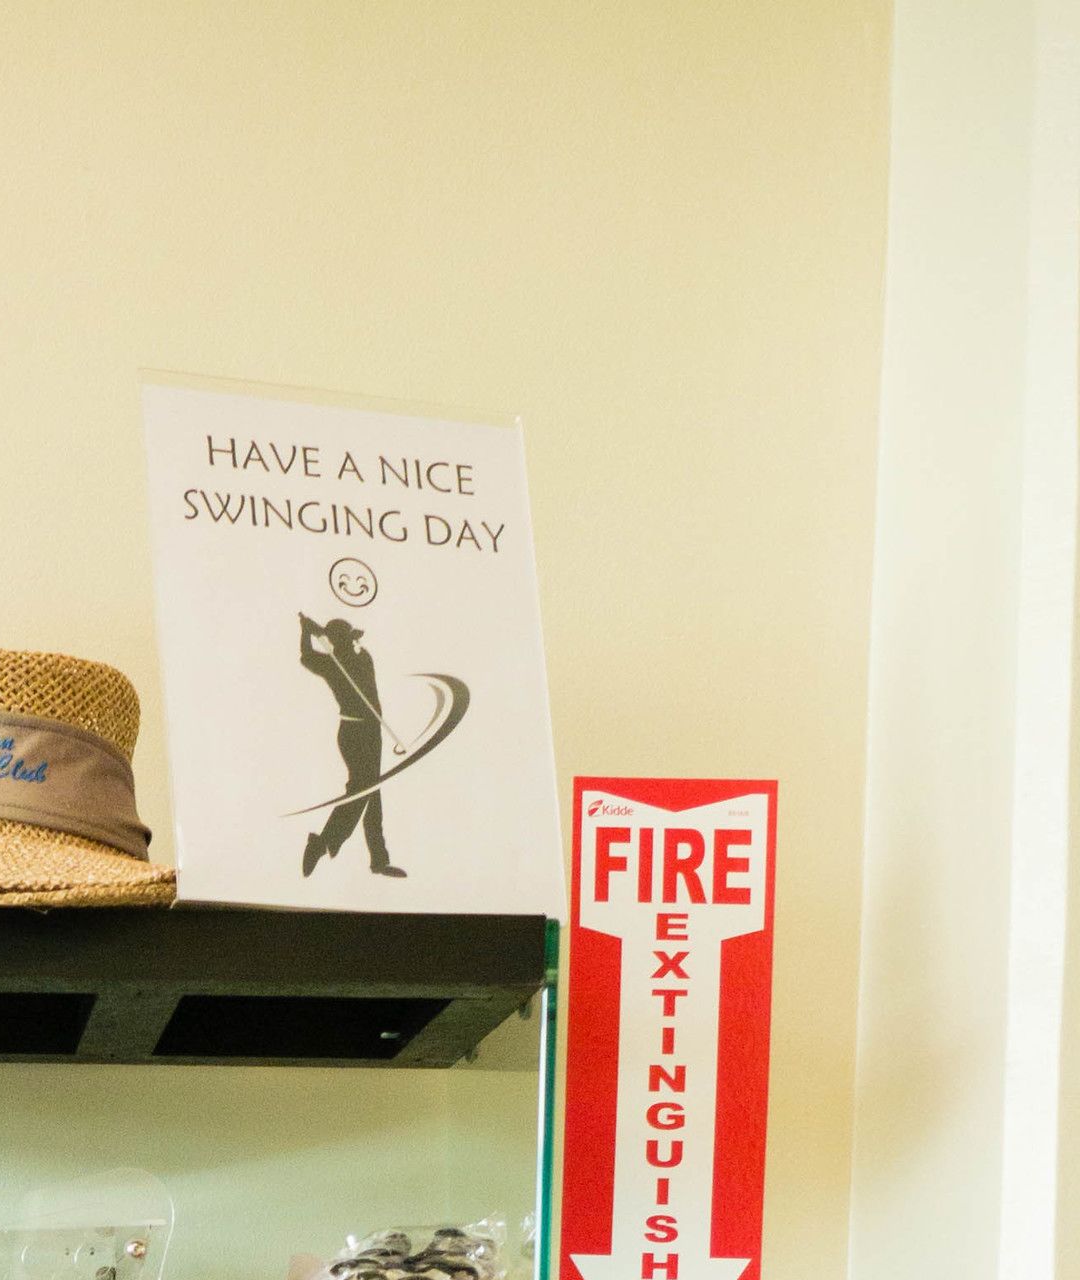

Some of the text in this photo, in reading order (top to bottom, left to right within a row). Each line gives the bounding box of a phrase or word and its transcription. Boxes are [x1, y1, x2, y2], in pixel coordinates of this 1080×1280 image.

[206, 434, 477, 497] HAVE A NICE
[182, 488, 506, 554] SWINGING DAY
[602, 803, 635, 817] Kidde
[593, 825, 753, 906] FIRE
